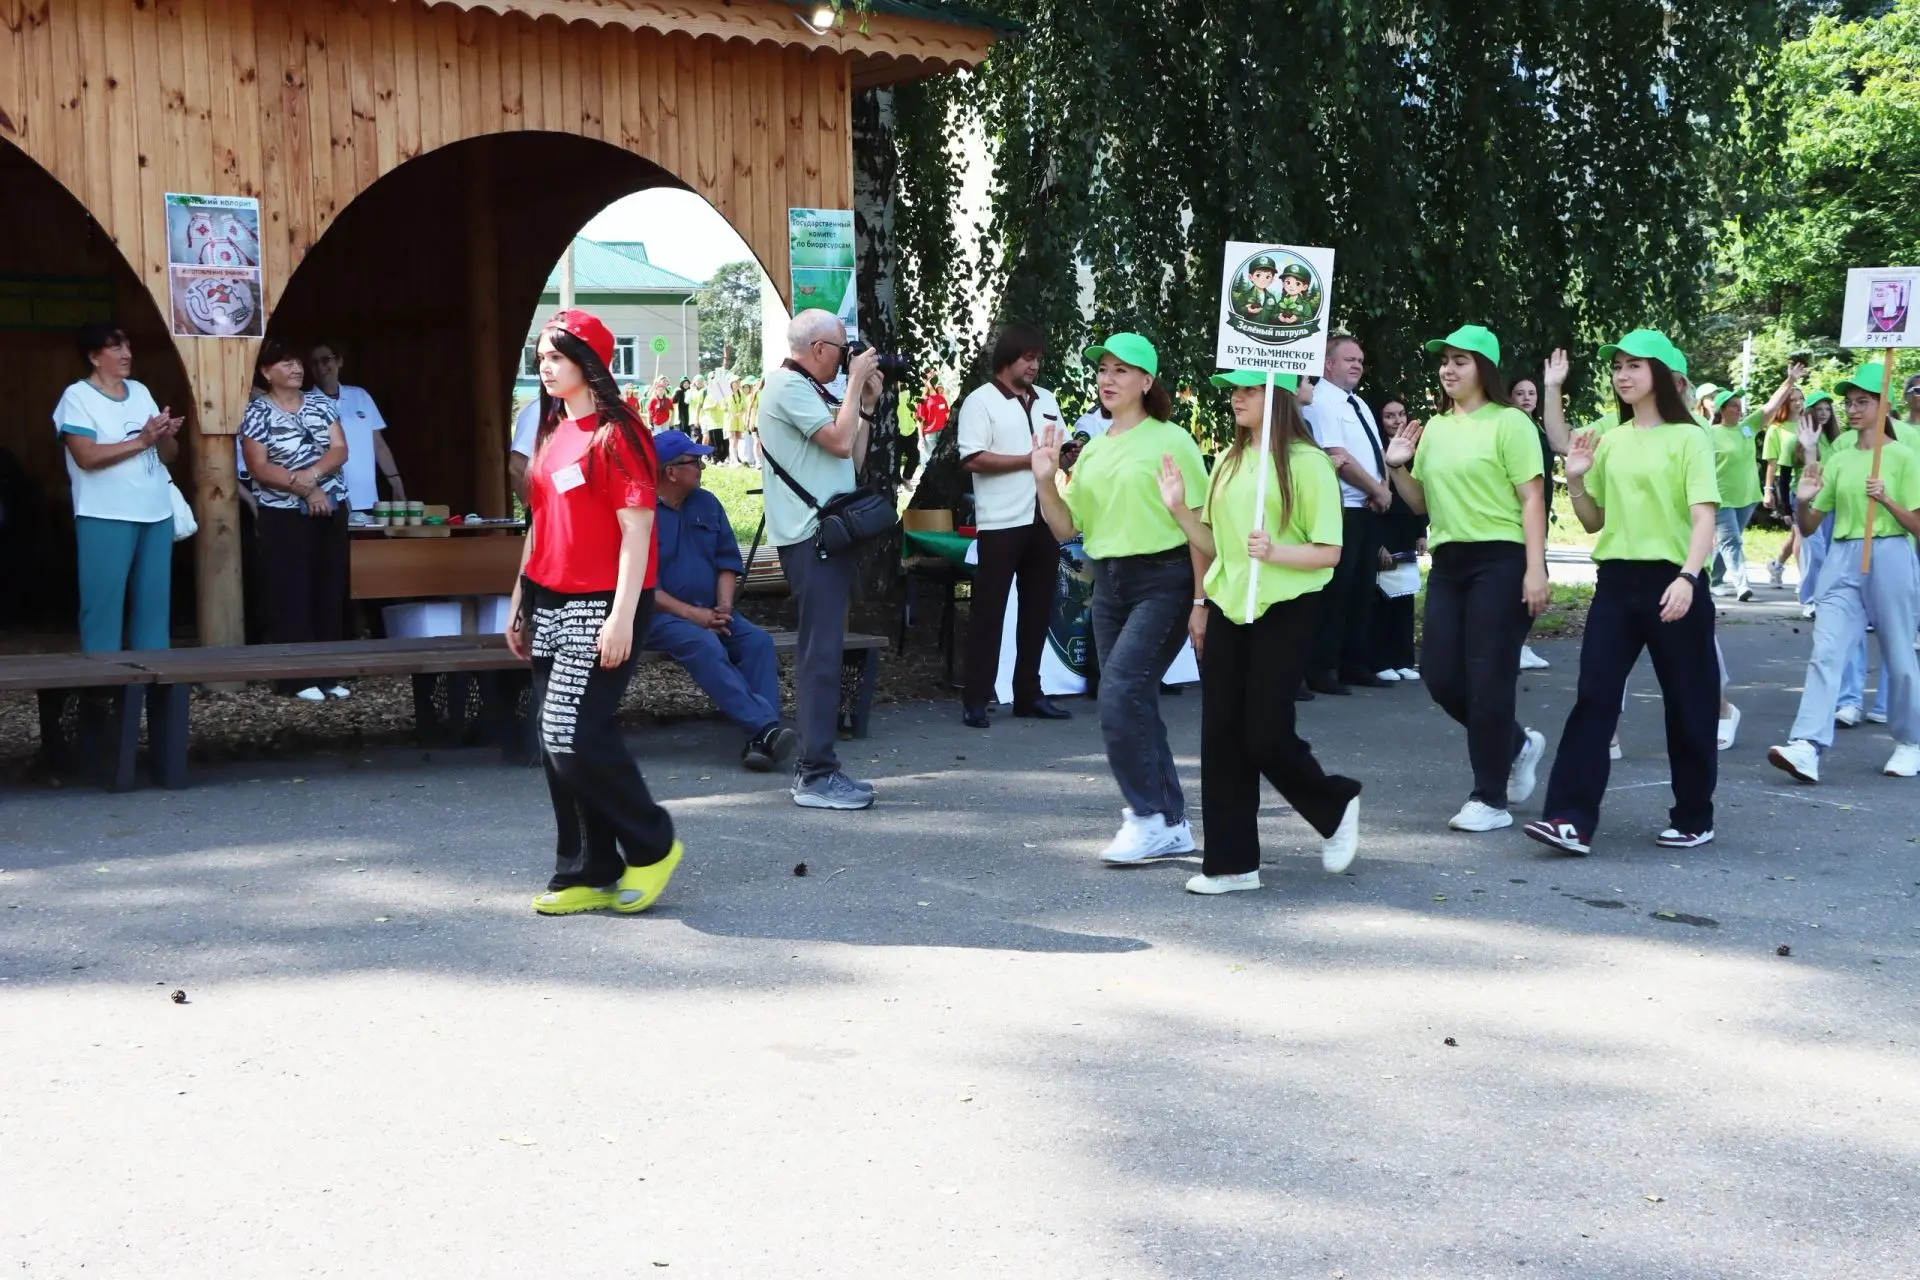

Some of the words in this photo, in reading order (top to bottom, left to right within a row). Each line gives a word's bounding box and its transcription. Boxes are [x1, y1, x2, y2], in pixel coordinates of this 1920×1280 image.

[792, 218, 852, 229] Государственный
[808, 230, 837, 238] комитет
[806, 241, 851, 250] биоресурсам
[1236, 320, 1274, 337] Зелёный
[1274, 328, 1309, 338] патруль
[1866, 334, 1903, 343] РУНГА
[1227, 345, 1316, 361] БУГУЛЬМИНСКОЕ
[1234, 356, 1307, 371] ЛЕСНИЧЕСТВО
[587, 600, 608, 608] AND
[595, 609, 606, 617] IN
